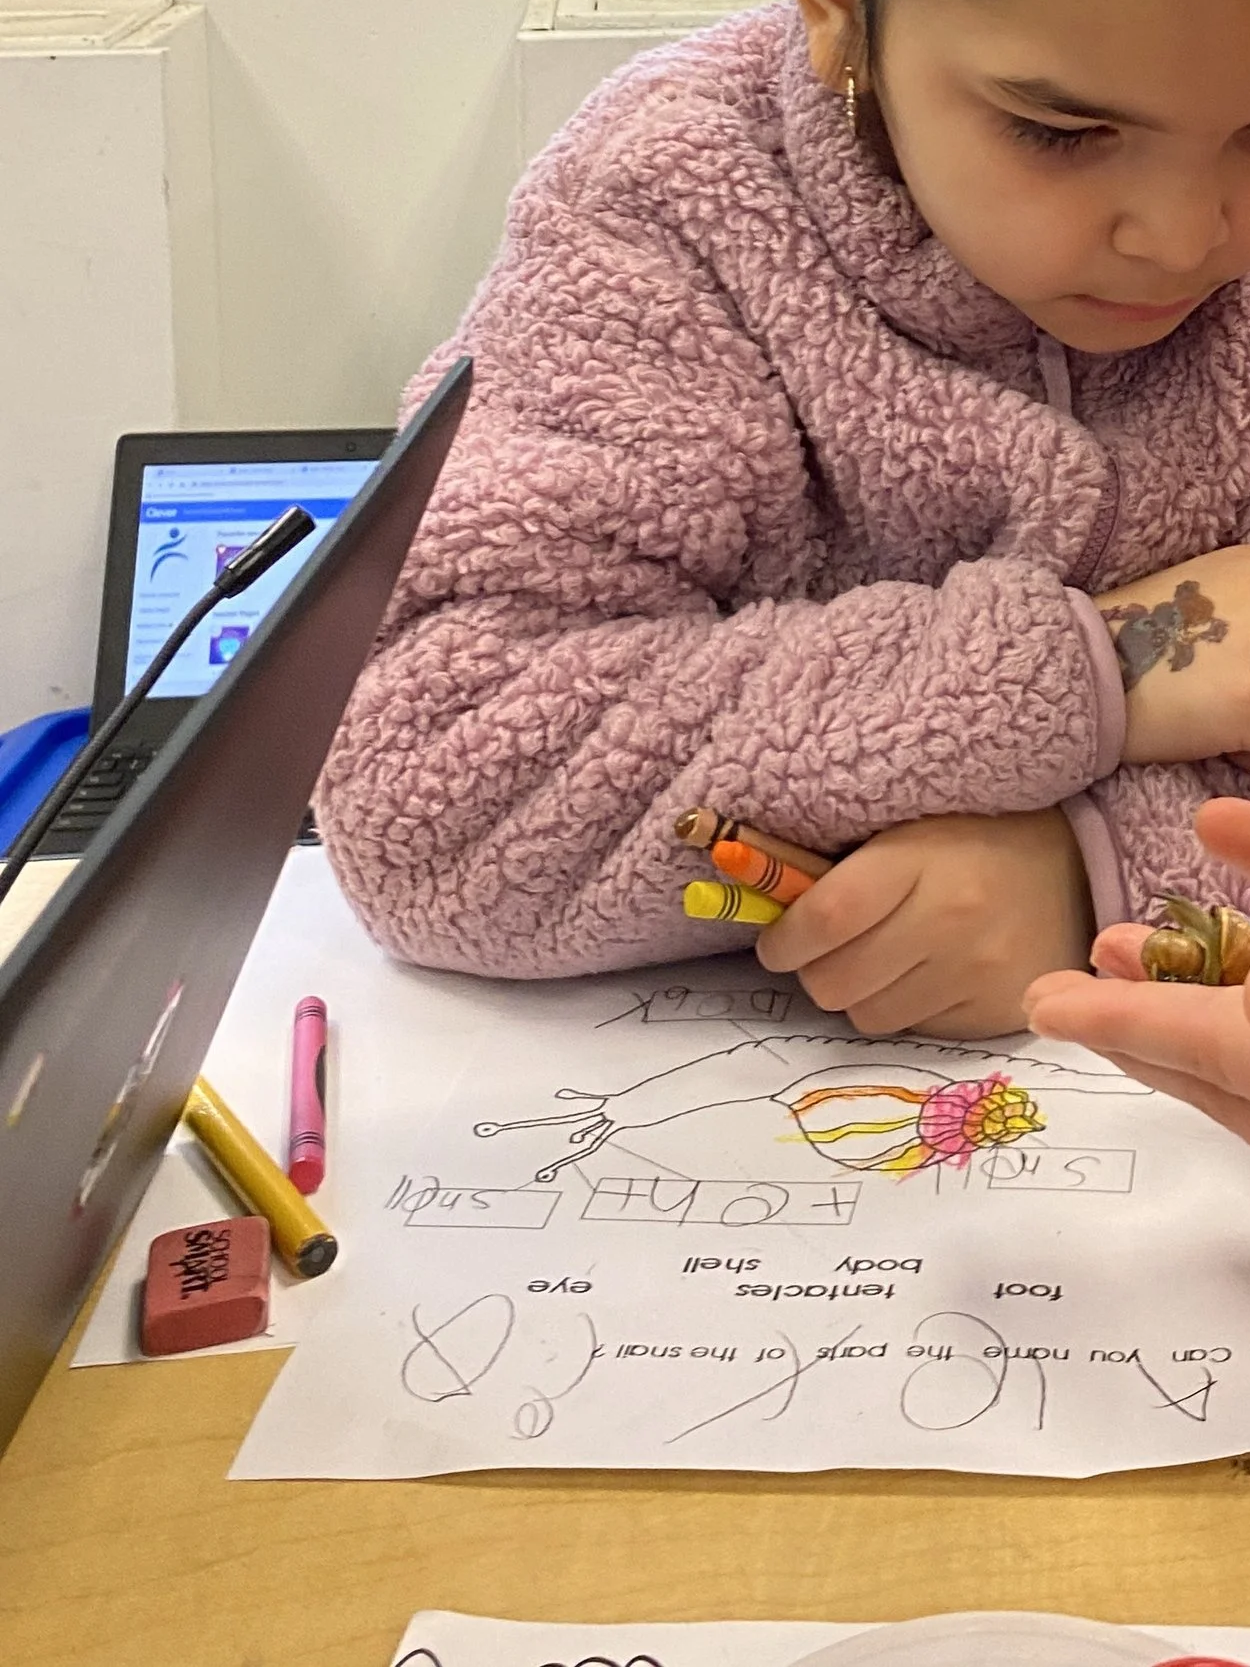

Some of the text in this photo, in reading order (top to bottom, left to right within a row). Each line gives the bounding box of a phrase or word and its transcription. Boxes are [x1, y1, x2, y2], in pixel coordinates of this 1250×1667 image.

[682, 1256, 924, 1274] body shell
[527, 1278, 1064, 1301] foot tentacles eye
[616, 1343, 683, 1360] snail
[691, 1343, 738, 1361] the
[756, 1344, 785, 1363] of
[816, 1343, 888, 1361] parts
[907, 1344, 953, 1360] the
[983, 1345, 1070, 1361] name
[1089, 1346, 1141, 1364] you
